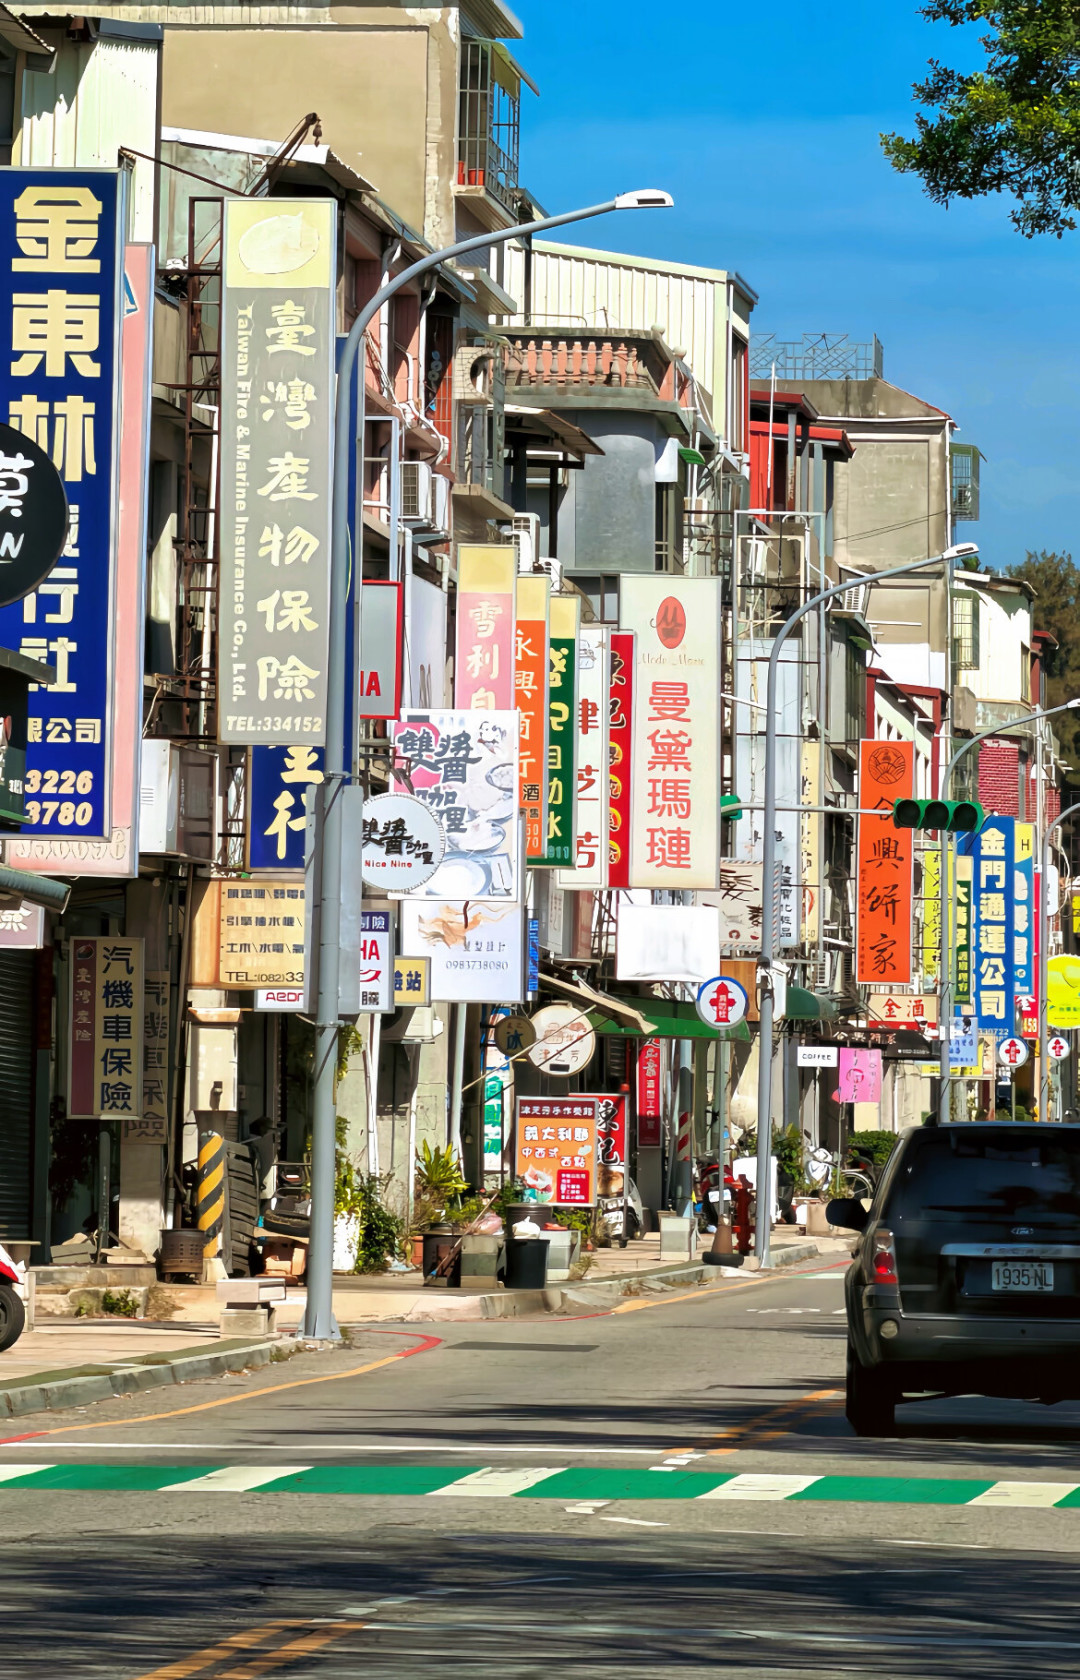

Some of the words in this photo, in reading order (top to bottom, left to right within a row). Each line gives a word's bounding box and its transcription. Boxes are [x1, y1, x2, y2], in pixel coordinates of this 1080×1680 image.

[236, 303, 253, 375] Taiwan
[236, 378, 252, 420] Fire
[236, 426, 249, 440] &
[235, 444, 250, 512] Marine
[234, 516, 249, 614] Insurance
[233, 663, 247, 701] Ltd.
[226, 715, 322, 733] TEL:334152
[25, 769, 93, 794] 3226
[646, 680, 692, 869] 曼黛瑪璉
[25, 801, 93, 826] 3780
[882, 997, 924, 1018] 金酒
[101, 946, 134, 1110] 汽機車保險
[802, 1053, 832, 1061] COFFEE
[995, 1268, 1053, 1287] 1935-NL
